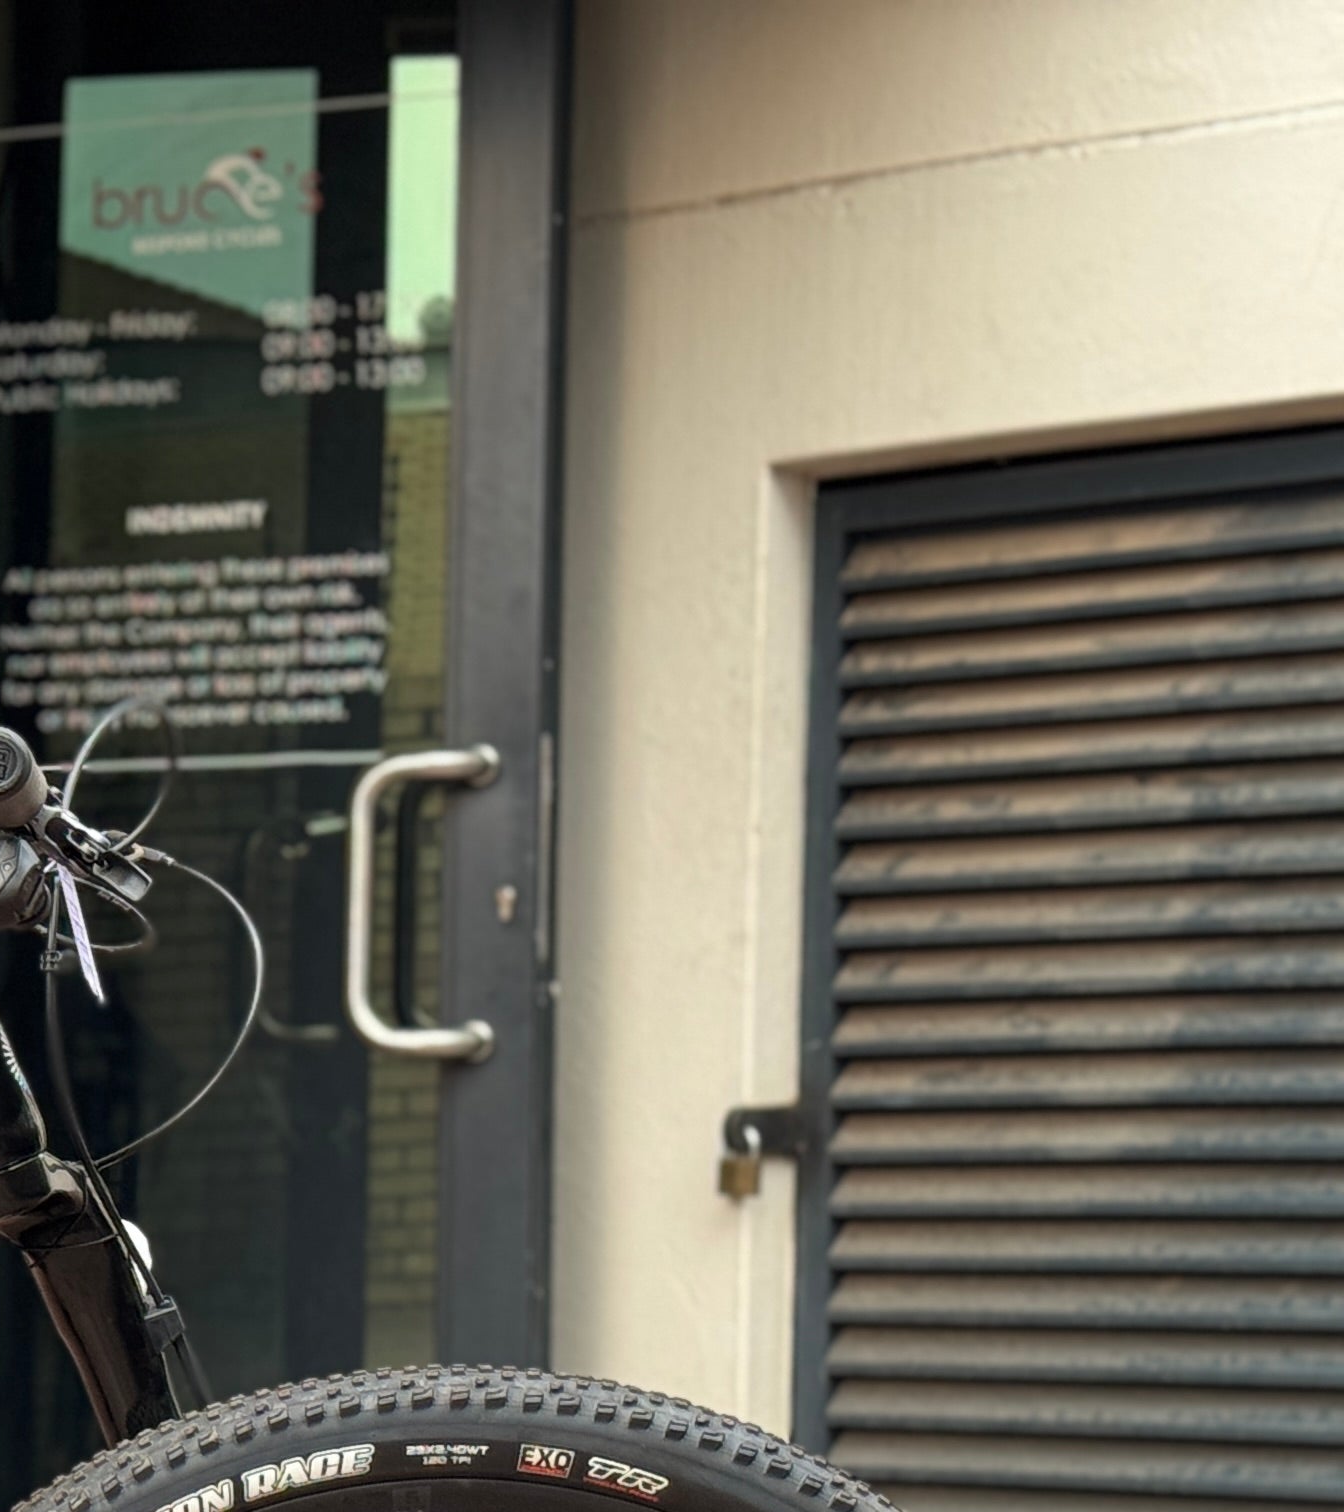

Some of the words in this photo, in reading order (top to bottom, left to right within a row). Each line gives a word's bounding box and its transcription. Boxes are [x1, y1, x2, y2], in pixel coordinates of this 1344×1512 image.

[126, 500, 267, 535] INDEMNITY
[243, 1443, 375, 1503] RACE
[521, 1448, 572, 1470] EXO
[588, 1456, 669, 1495] TR
